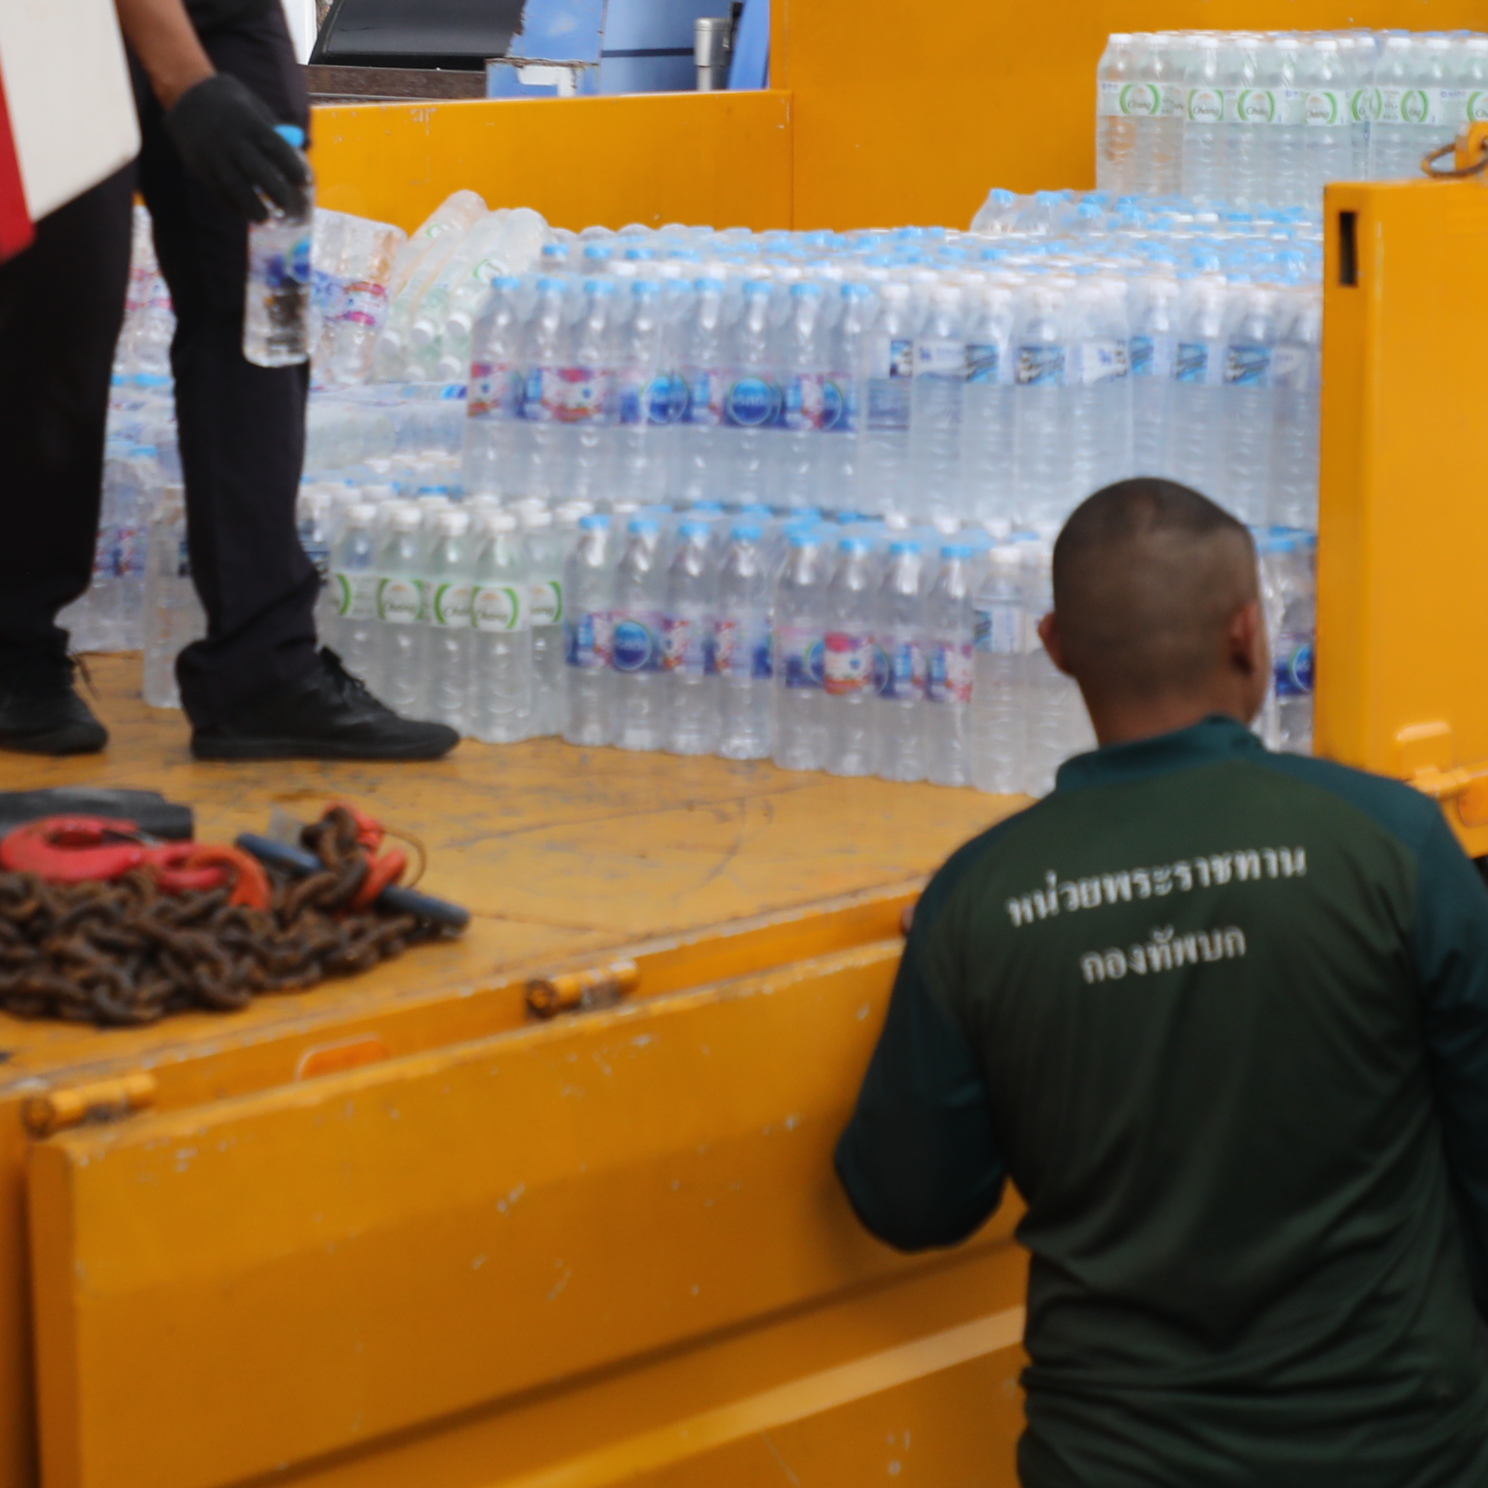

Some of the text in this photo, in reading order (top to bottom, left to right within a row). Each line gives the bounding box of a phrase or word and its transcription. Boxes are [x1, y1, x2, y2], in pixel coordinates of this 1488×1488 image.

[1006, 844, 1308, 928] หน่วยพระราชทาน
[1079, 924, 1247, 985] กองทัพบก
